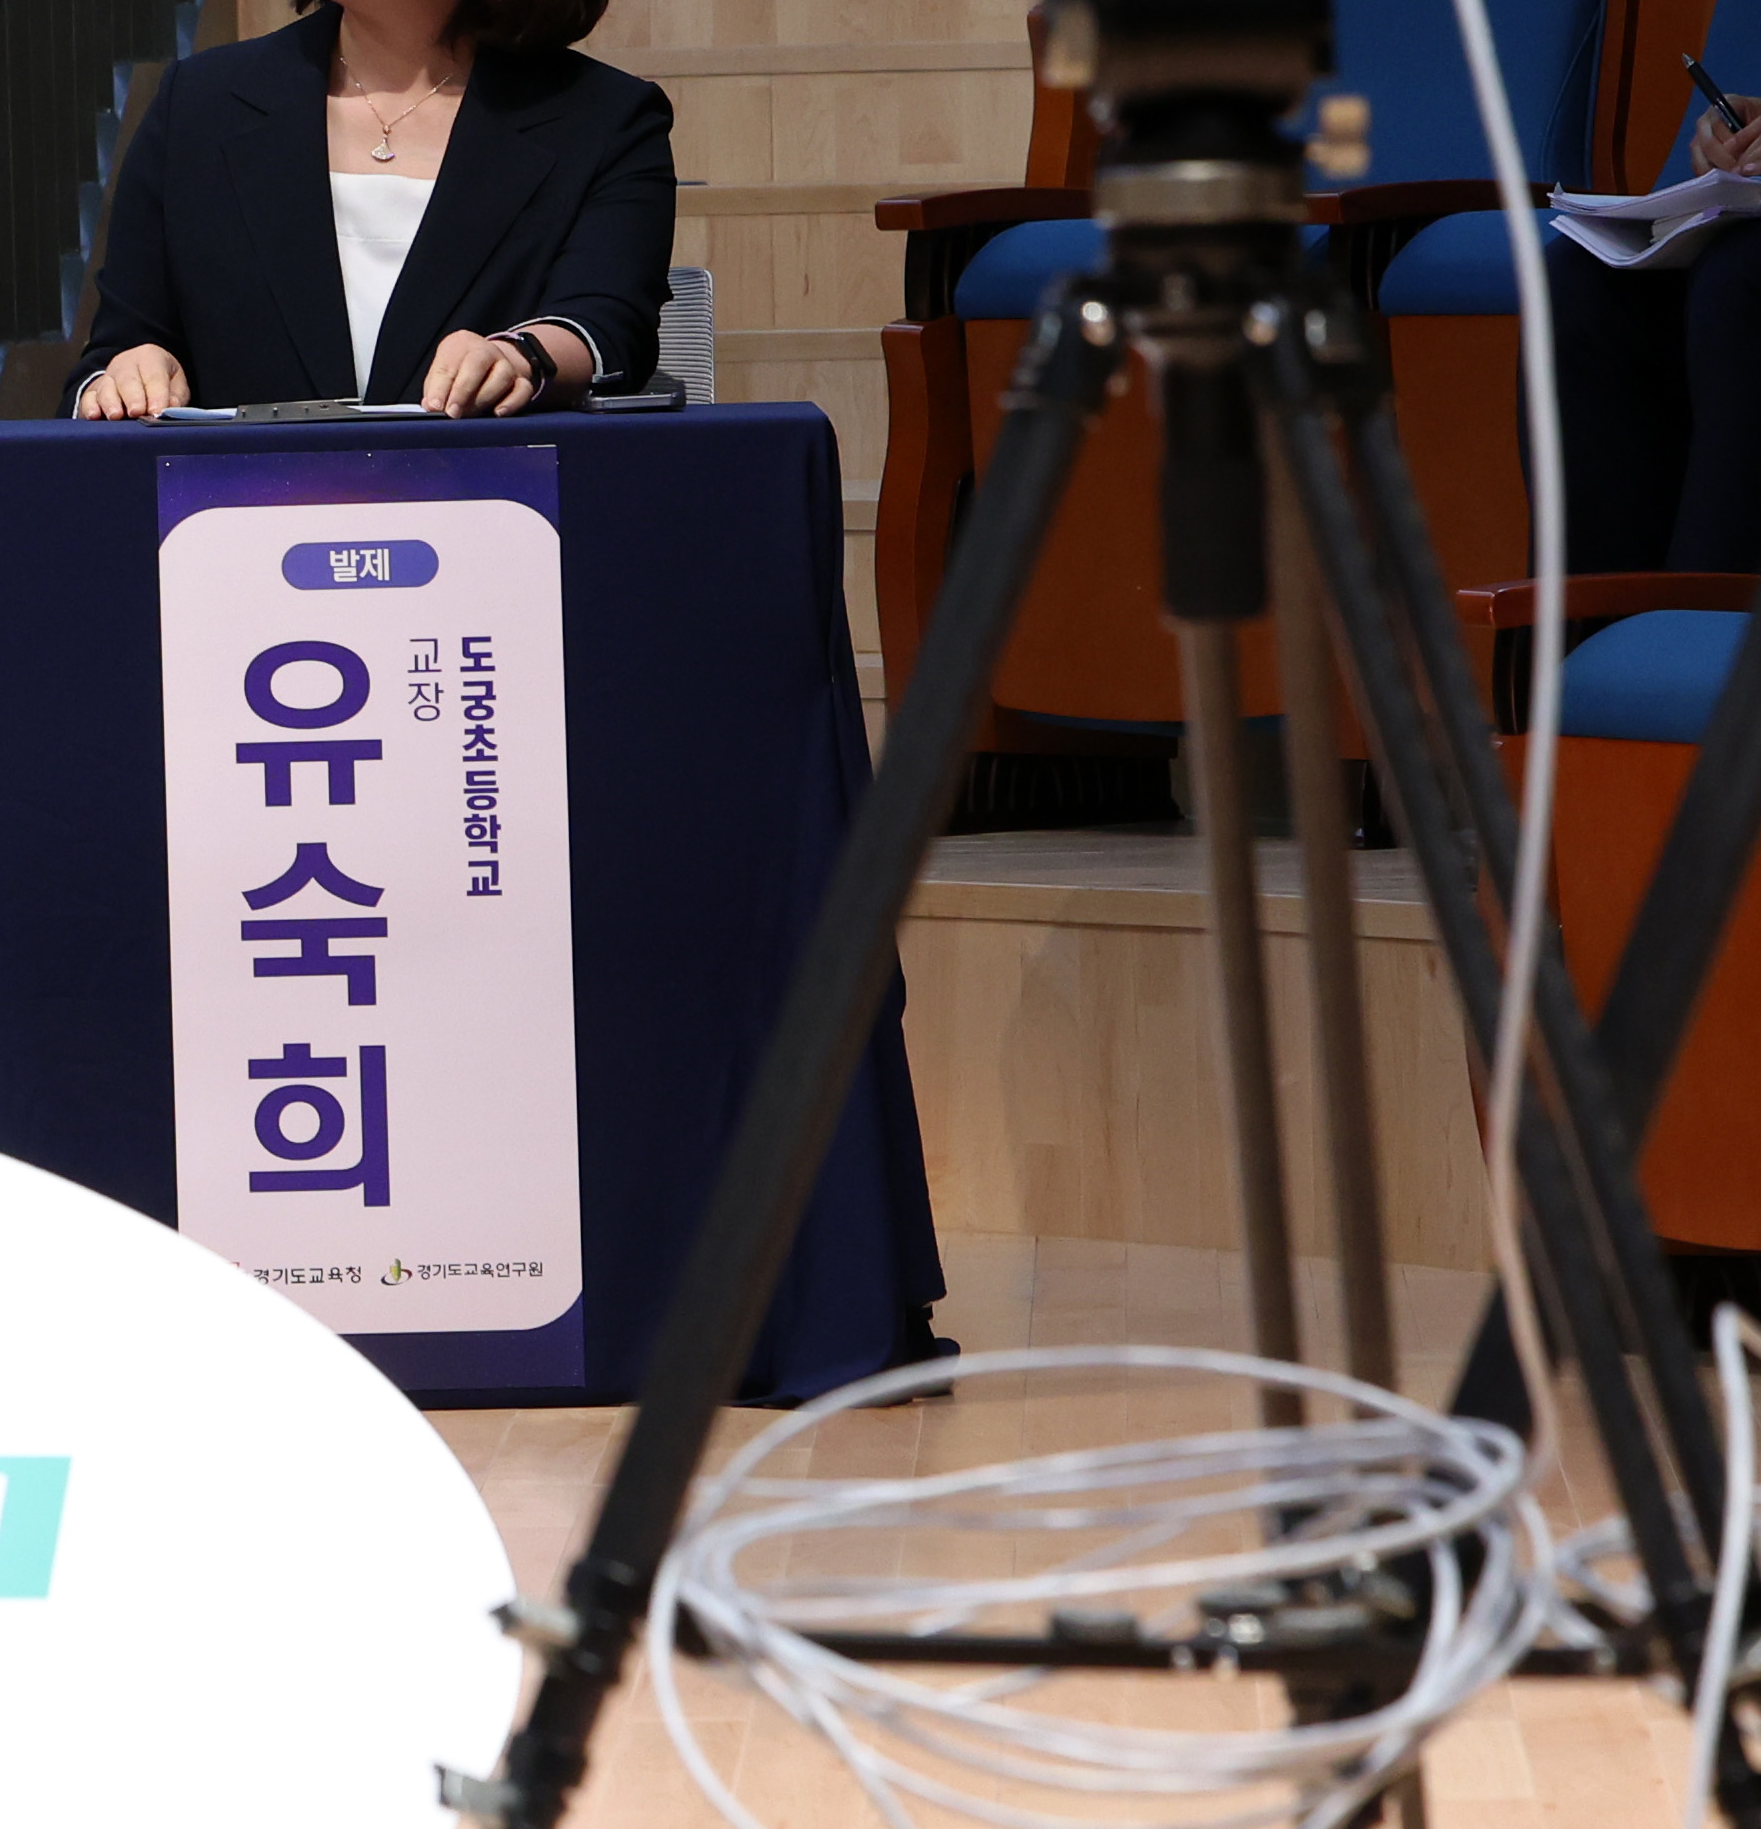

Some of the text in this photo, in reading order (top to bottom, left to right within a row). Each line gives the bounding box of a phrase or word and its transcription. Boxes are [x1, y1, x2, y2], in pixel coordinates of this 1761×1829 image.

[328, 547, 391, 583] 발제
[407, 638, 444, 722] 교장
[460, 636, 503, 896] 도궁초등학교
[235, 640, 392, 1208] 유숙희
[253, 1266, 362, 1285] 경기도교육청
[417, 1262, 543, 1280] 경기도교육연구원
